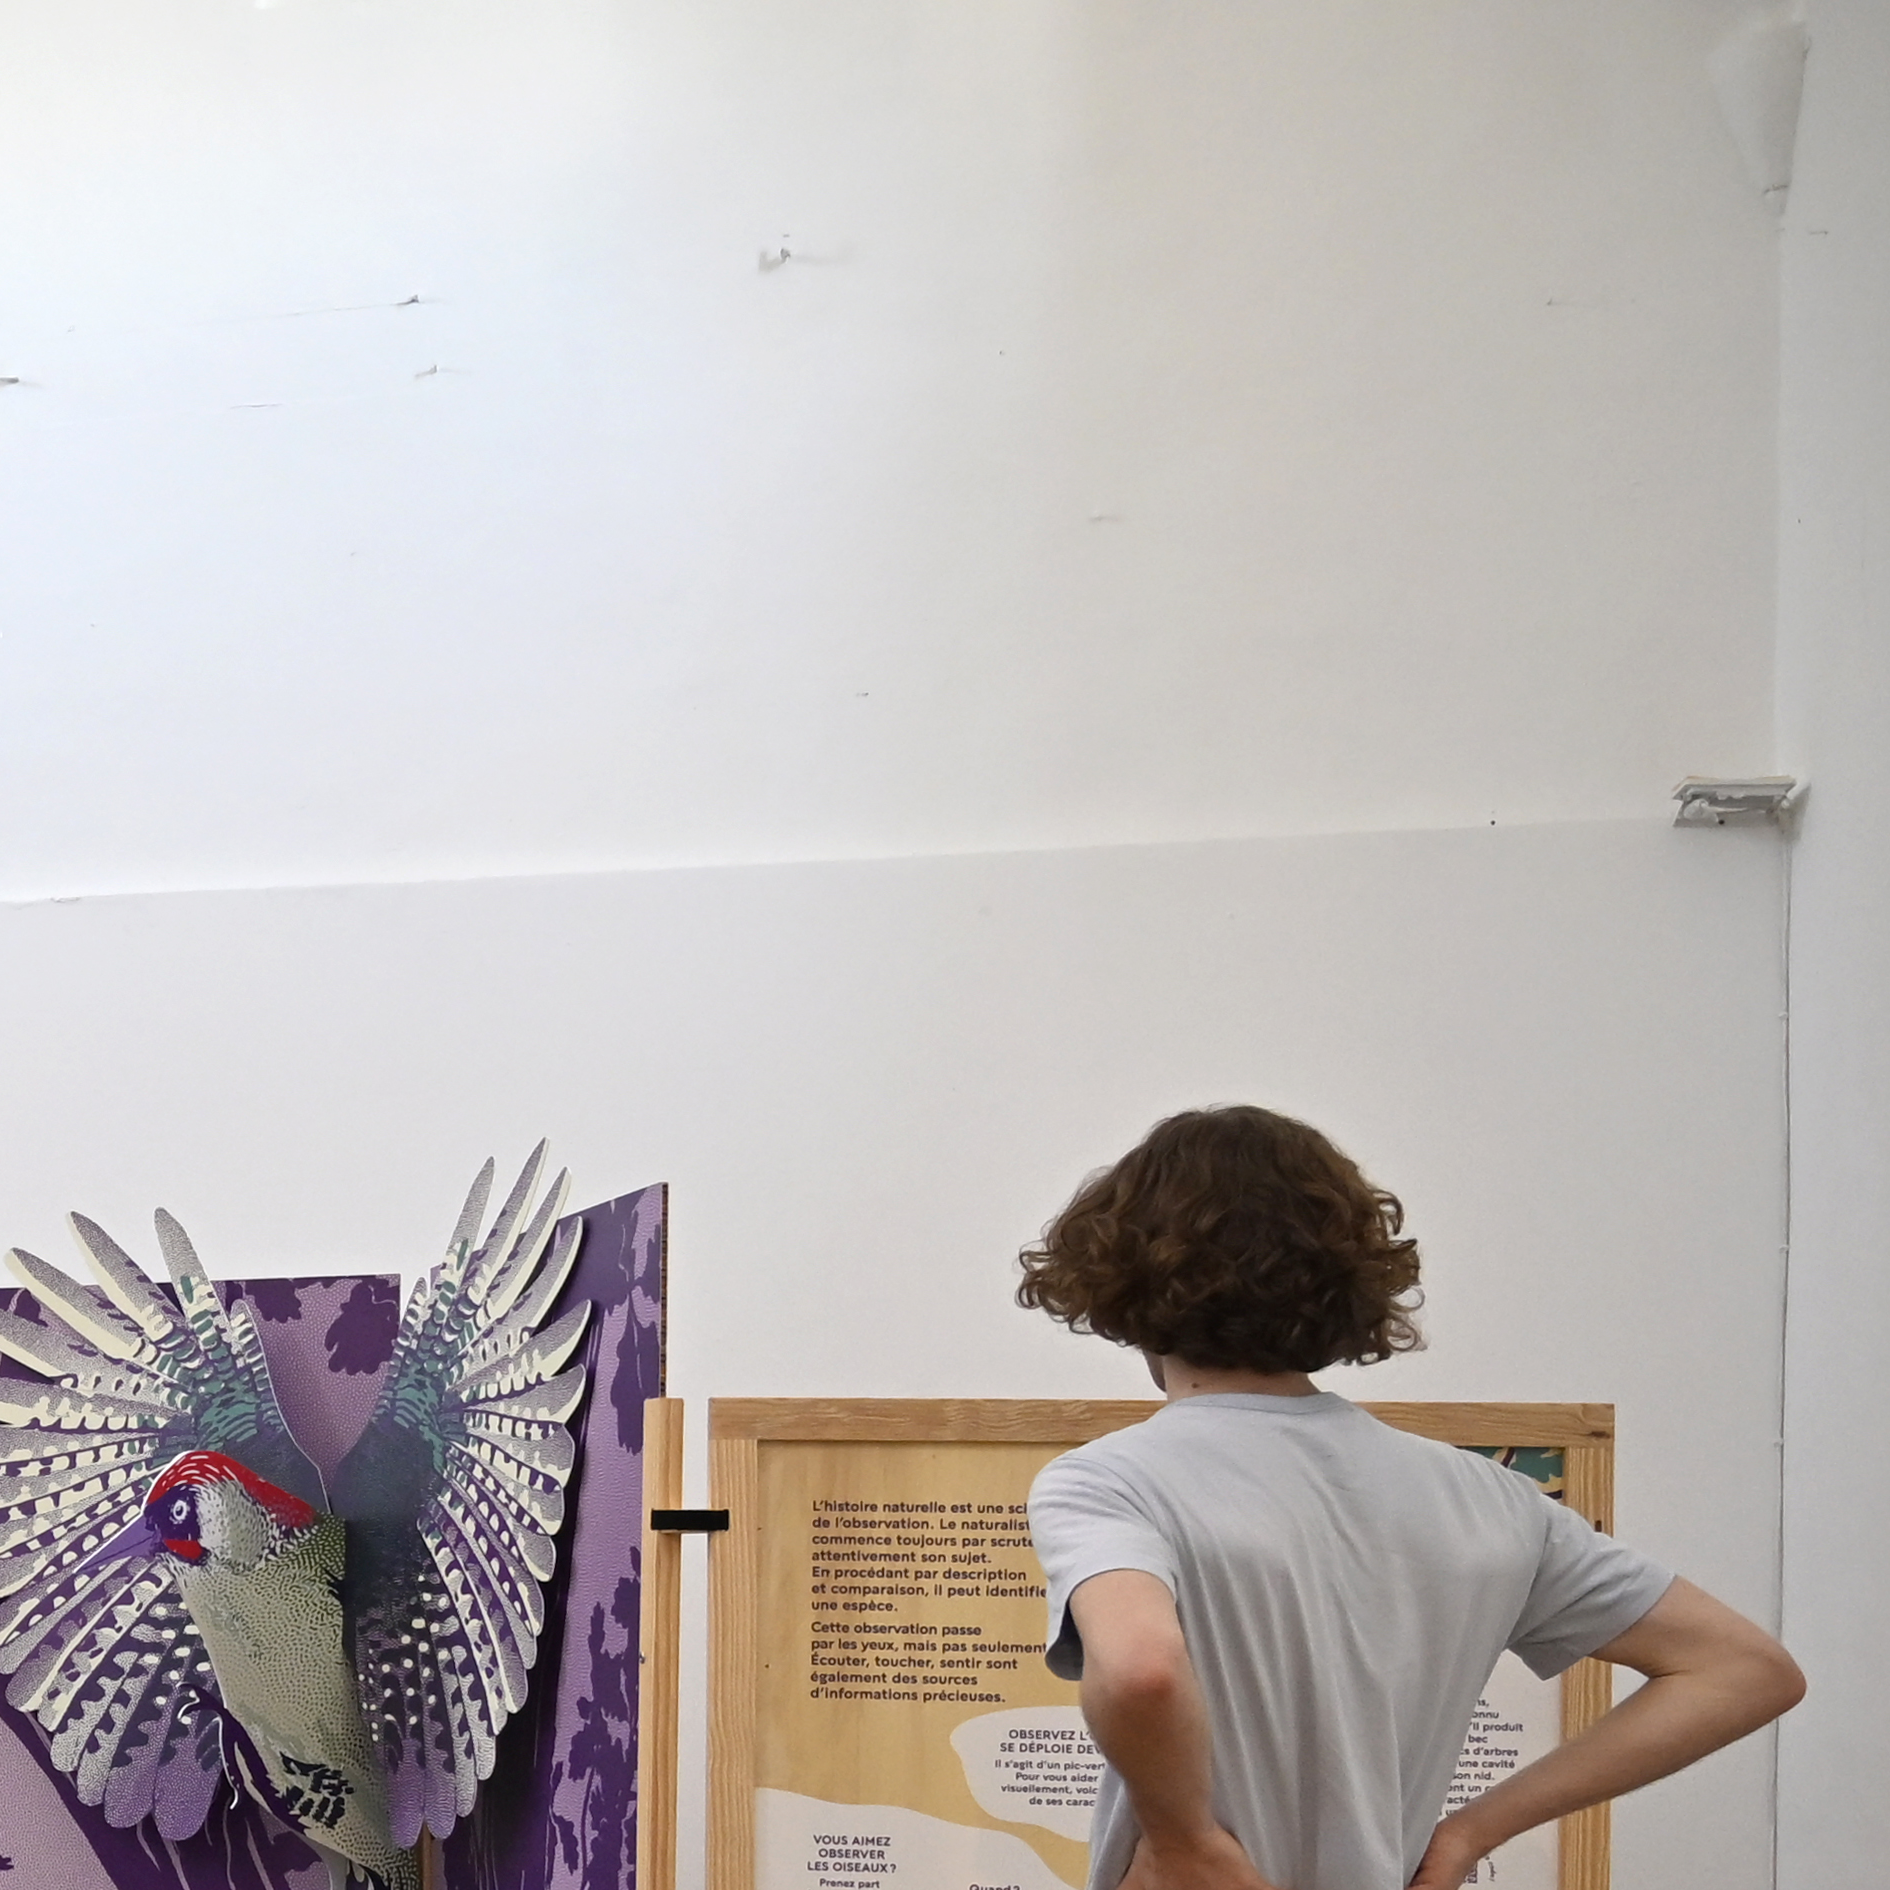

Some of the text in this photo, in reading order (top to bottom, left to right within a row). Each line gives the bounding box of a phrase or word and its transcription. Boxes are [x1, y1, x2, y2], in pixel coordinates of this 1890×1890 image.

[813, 1500, 878, 1512] L'histoire
[883, 1501, 946, 1513] naturelle
[951, 1503, 972, 1513] est
[977, 1505, 1004, 1514] une
[812, 1516, 1030, 1531] de l'observation. Le naturalist
[812, 1536, 892, 1546] commence
[896, 1534, 957, 1548] toujours
[962, 1538, 986, 1549] par
[812, 1550, 991, 1566] attentivement son sujet.
[812, 1566, 1026, 1583] En procédant par description
[811, 1582, 826, 1594] et
[831, 1584, 929, 1597] comparaison,
[934, 1584, 942, 1596] il
[948, 1586, 981, 1598] peut
[812, 1600, 898, 1613] une espèce.
[811, 1621, 982, 1637] Cette observation passe
[811, 1640, 835, 1652] par
[838, 1638, 857, 1650] les
[861, 1641, 899, 1653] yeux,
[903, 1640, 937, 1651] mais
[942, 1643, 967, 1654] pas
[811, 1652, 1018, 1669] Écouter, toucher, sentir sont
[810, 1671, 978, 1685] également des sources
[810, 1687, 1005, 1703] d'informations précieuses.
[1009, 1729, 1075, 1740] OBSERVEZ
[1482, 1723, 1524, 1733] produit
[1468, 1735, 1488, 1744] bec
[1000, 1741, 1073, 1754] SE DÉPLOIE
[1473, 1748, 1519, 1757] d'arbres
[1482, 1759, 1515, 1769] cavité
[1474, 1772, 1495, 1781] nid.
[813, 1835, 891, 1847] VOUS AIMEZ
[818, 1848, 885, 1860] OBSERVER
[807, 1861, 829, 1871] LES
